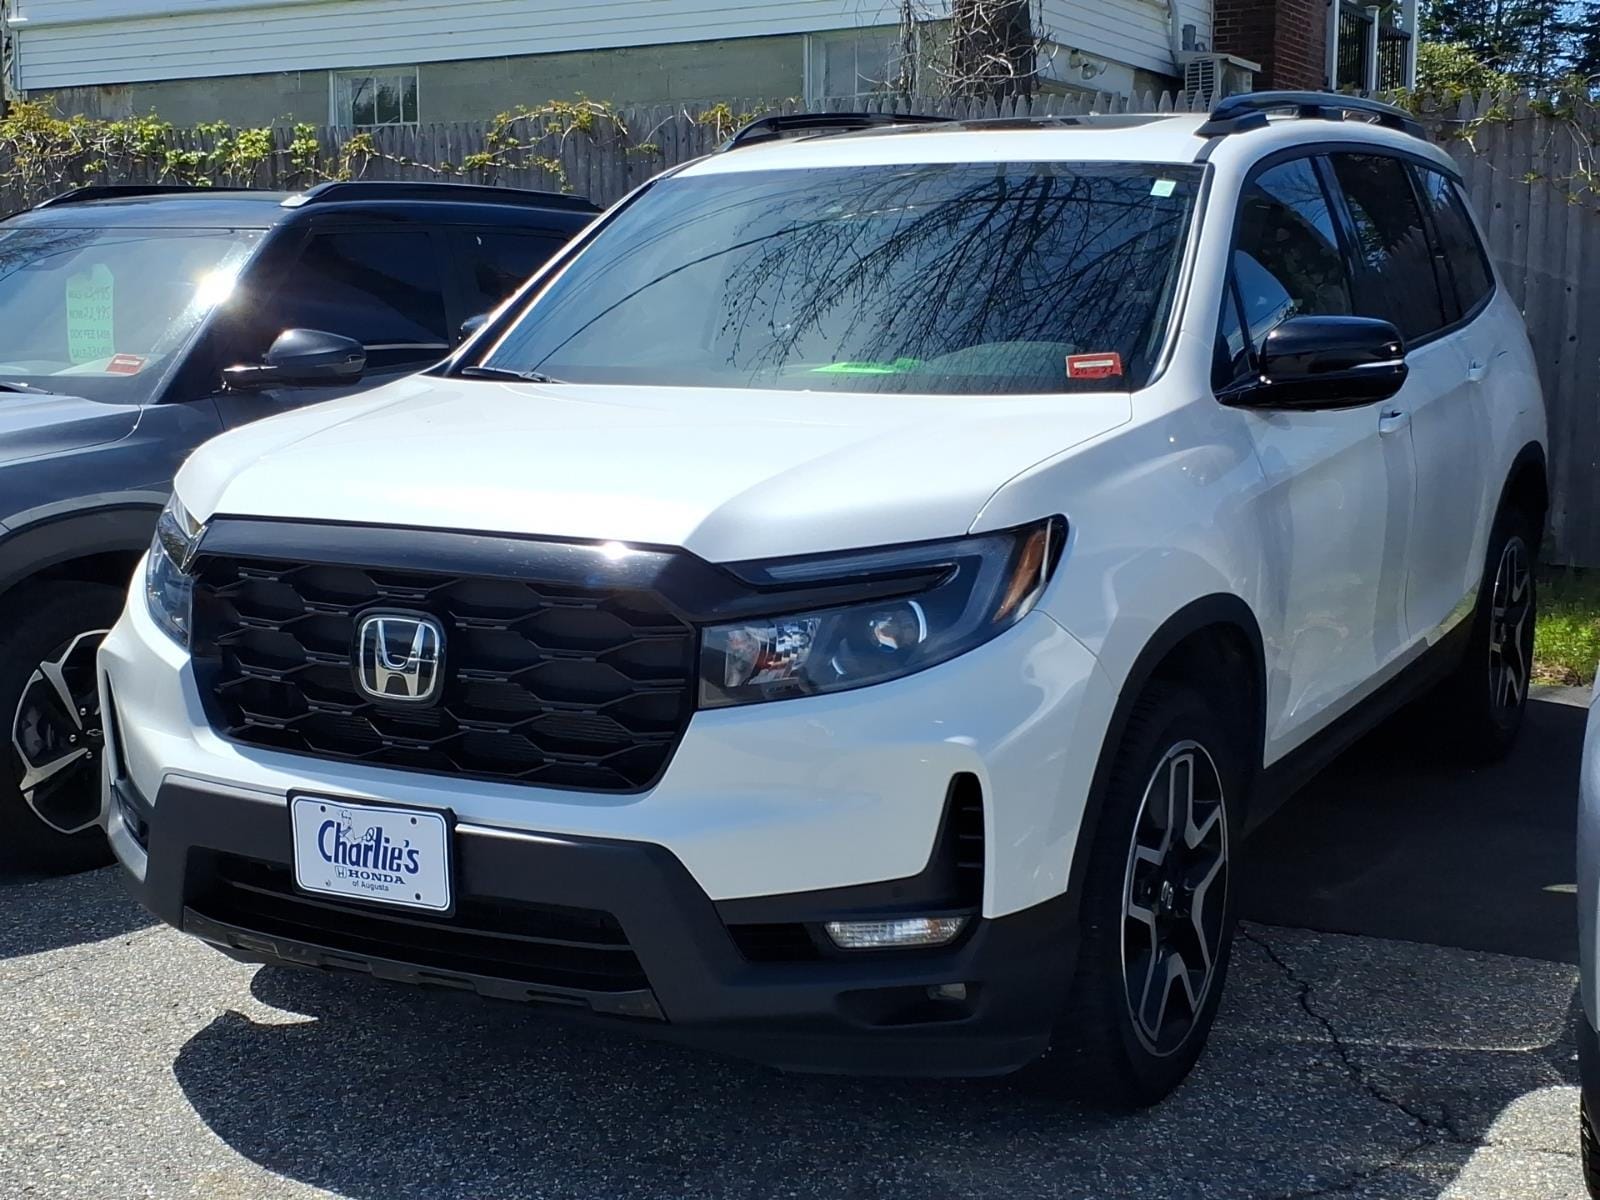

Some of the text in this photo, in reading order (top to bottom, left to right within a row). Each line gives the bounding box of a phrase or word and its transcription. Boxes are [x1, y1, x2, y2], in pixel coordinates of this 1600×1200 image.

[317, 819, 420, 875] Charlie's
[347, 869, 406, 885] HONDA
[361, 880, 389, 891] Augusta
